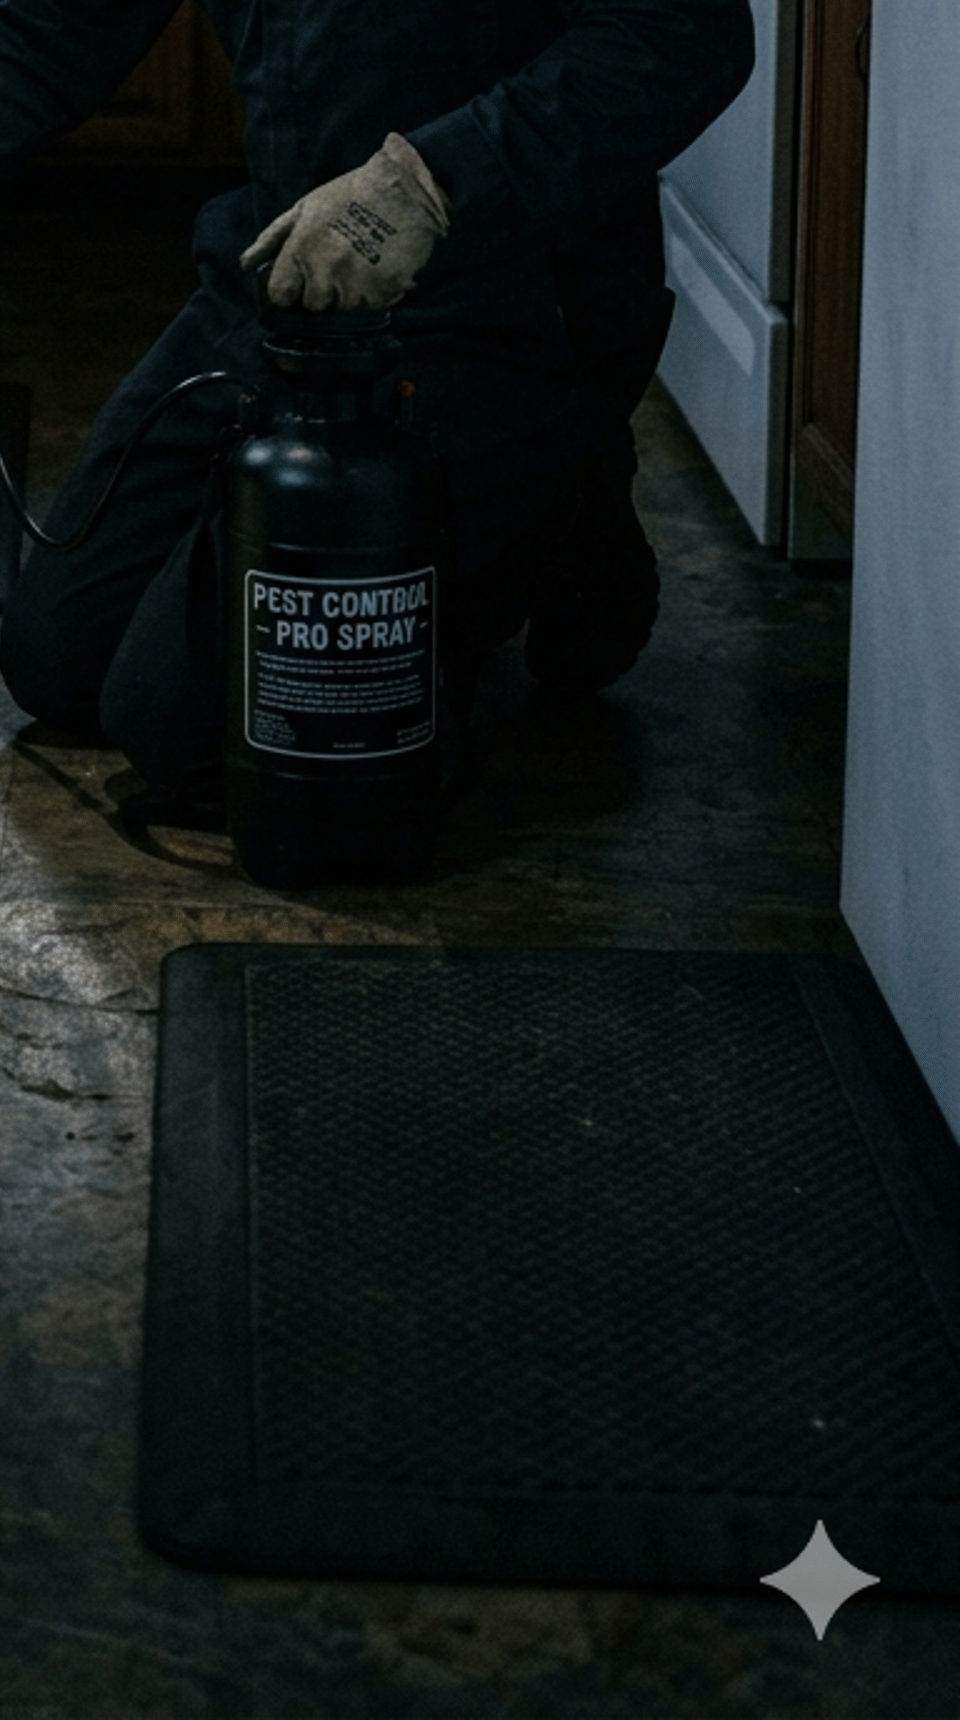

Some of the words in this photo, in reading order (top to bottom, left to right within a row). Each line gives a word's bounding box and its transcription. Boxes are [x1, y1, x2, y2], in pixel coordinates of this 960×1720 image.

[253, 582, 314, 617] PEST
[276, 619, 329, 651] PRO
[336, 615, 417, 651] SPRAY
